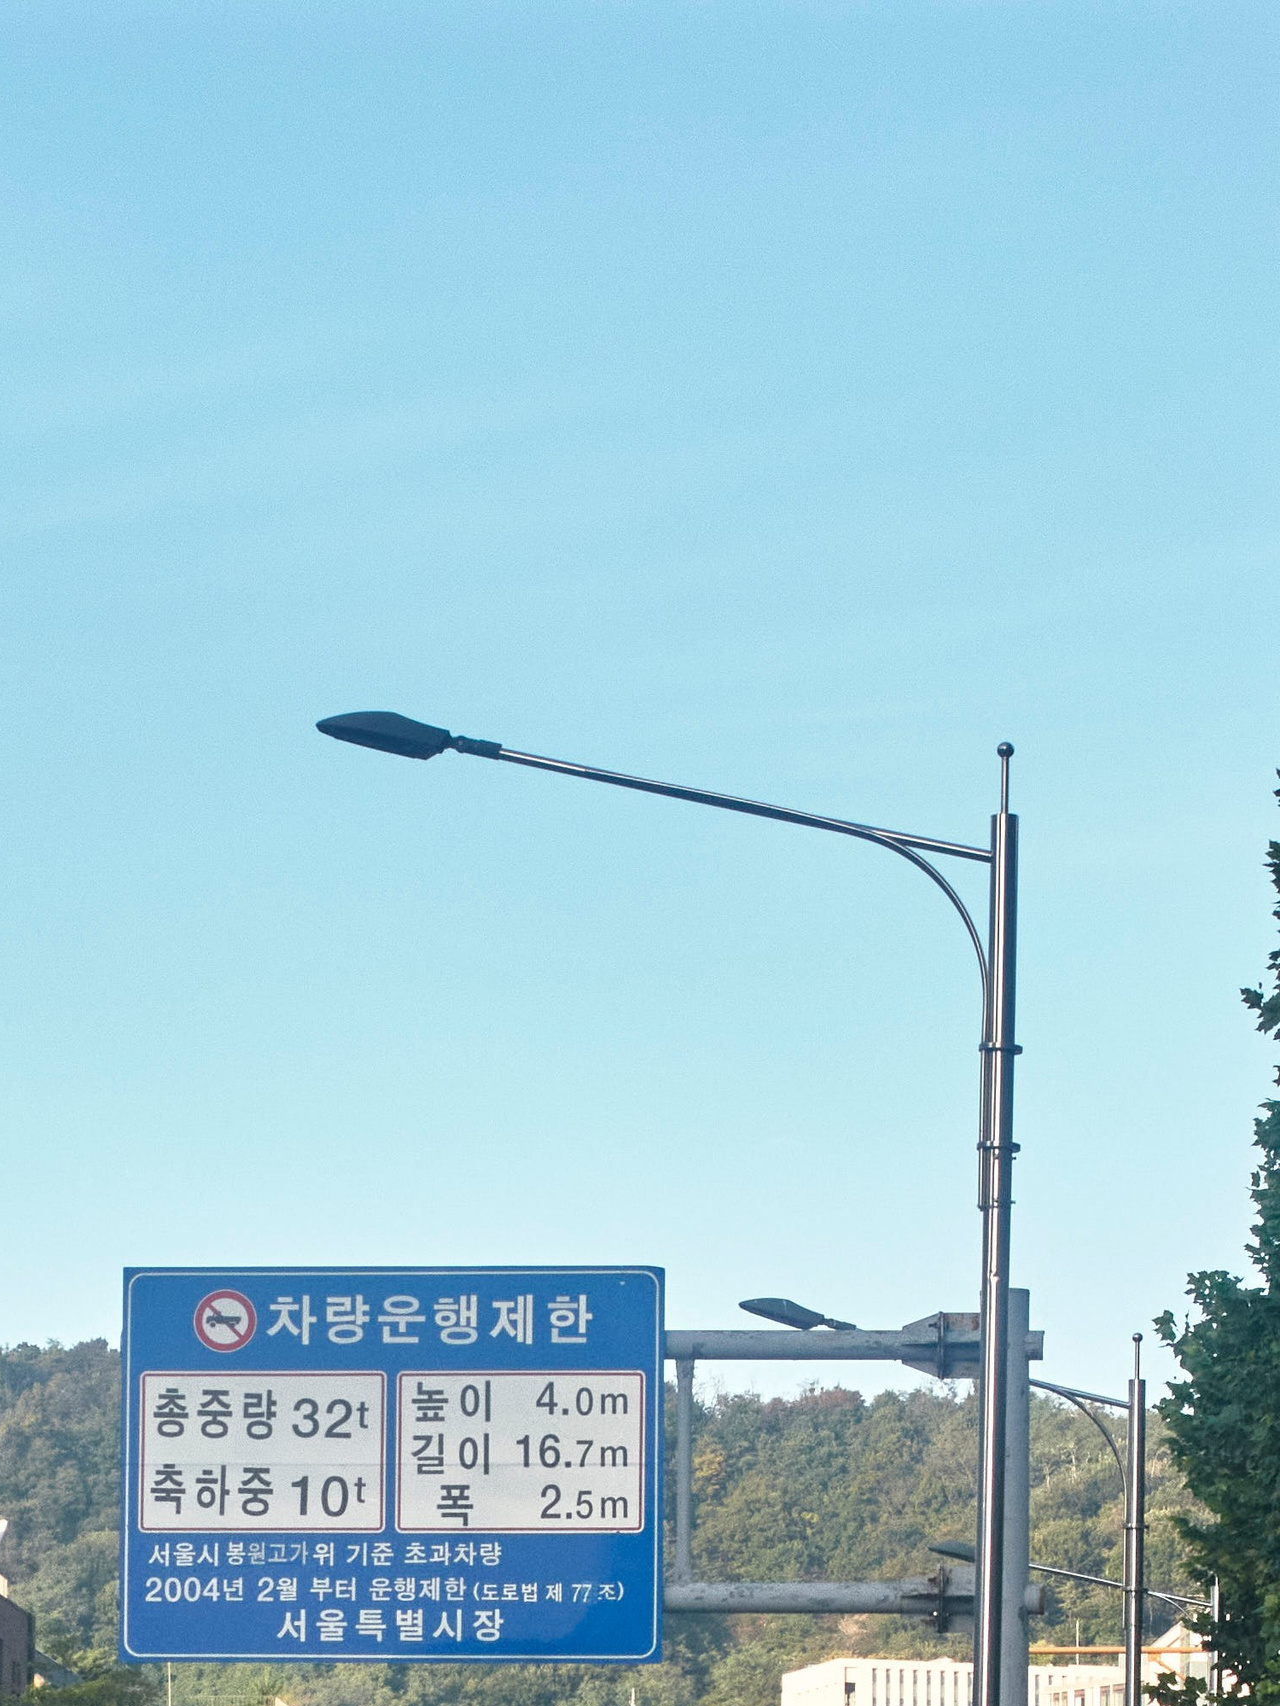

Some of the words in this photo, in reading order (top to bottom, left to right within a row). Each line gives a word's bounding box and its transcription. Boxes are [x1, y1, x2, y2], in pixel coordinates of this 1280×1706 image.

[266, 1293, 593, 1346] 차량운행제한
[152, 1386, 278, 1440] 총중량
[292, 1399, 370, 1440] 32t
[411, 1380, 493, 1424] 높이
[535, 1381, 629, 1417] 4.0m
[410, 1432, 491, 1475] 길이
[517, 1434, 629, 1469] 16.7m
[149, 1463, 275, 1517] 축하중
[291, 1474, 367, 1518] 10t
[435, 1483, 475, 1526] 폭
[540, 1484, 629, 1520] 2.5m
[148, 1542, 219, 1567] 서울시
[346, 1542, 394, 1567] 기준
[404, 1541, 502, 1567] 초과차량
[145, 1576, 244, 1602] 2004년
[257, 1576, 298, 1602] 2월
[310, 1576, 357, 1602] 부터
[369, 1576, 467, 1602] 운행제한
[276, 1608, 504, 1642] 서울특별시장
